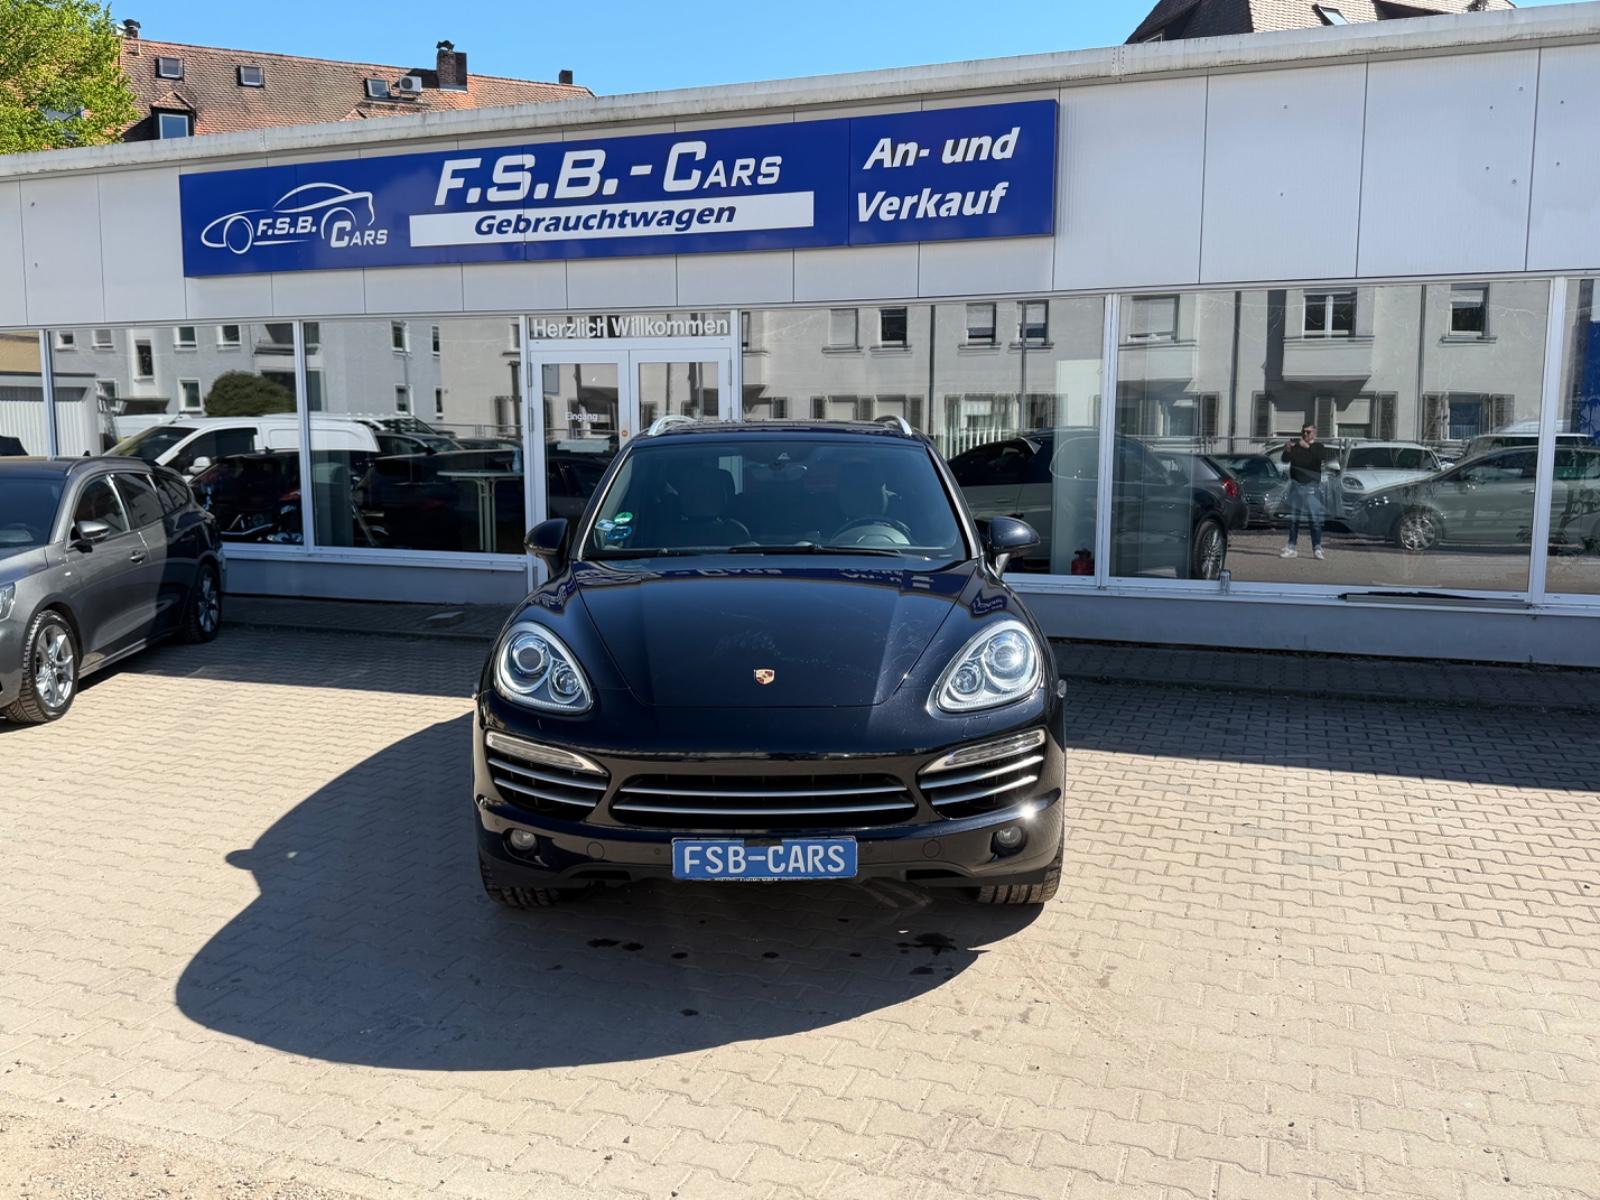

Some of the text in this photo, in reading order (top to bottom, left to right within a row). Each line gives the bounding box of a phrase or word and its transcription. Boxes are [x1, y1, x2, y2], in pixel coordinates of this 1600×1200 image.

[862, 126, 1021, 171] An- und
[857, 182, 1010, 223] Verkauf
[256, 215, 317, 237] F.S.B.
[475, 205, 736, 236] Gebrauchtwagen
[533, 317, 728, 338] Herzlich Willkommen
[565, 411, 598, 422] Eingang
[683, 845, 846, 874] FSB-CARS
